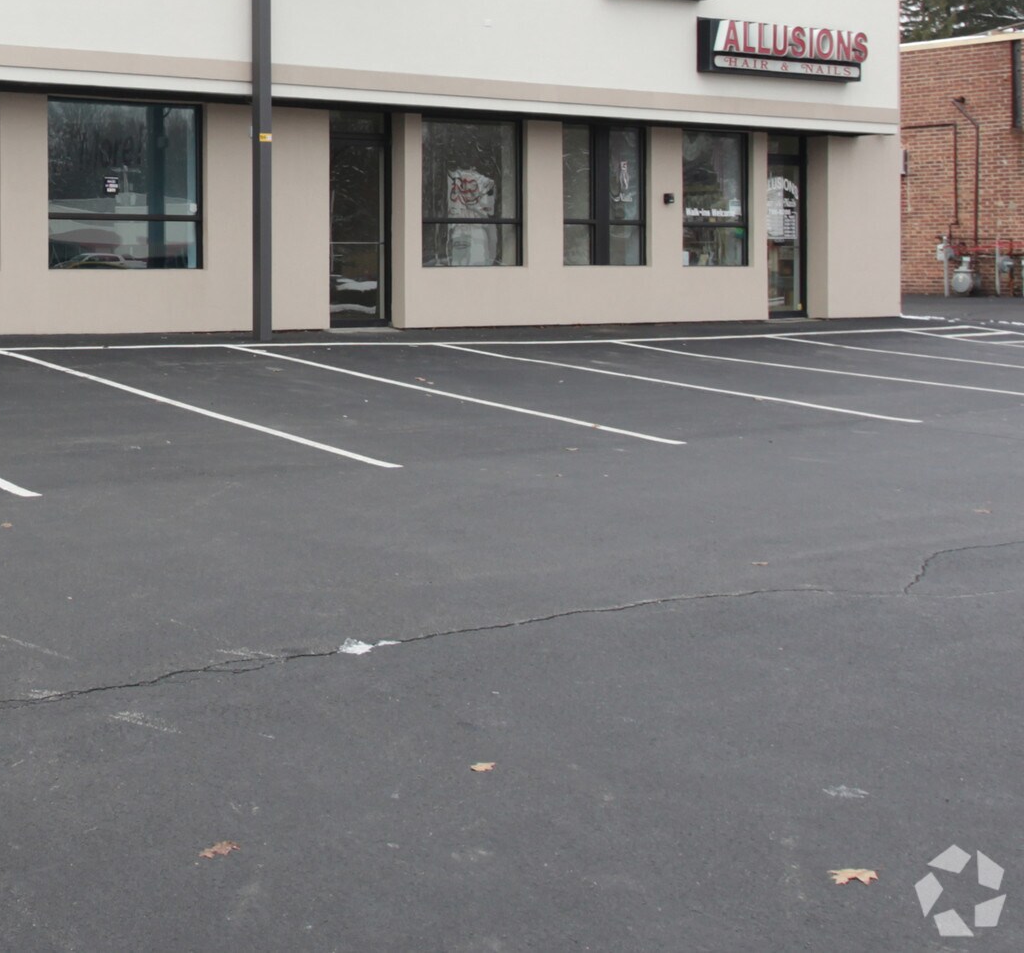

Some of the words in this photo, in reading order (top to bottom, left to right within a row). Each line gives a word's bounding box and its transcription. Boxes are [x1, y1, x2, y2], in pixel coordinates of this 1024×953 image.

[723, 20, 868, 63] ALLUSIONS
[724, 57, 768, 69] HAIR
[780, 61, 789, 71] &
[801, 64, 852, 77] NAILS
